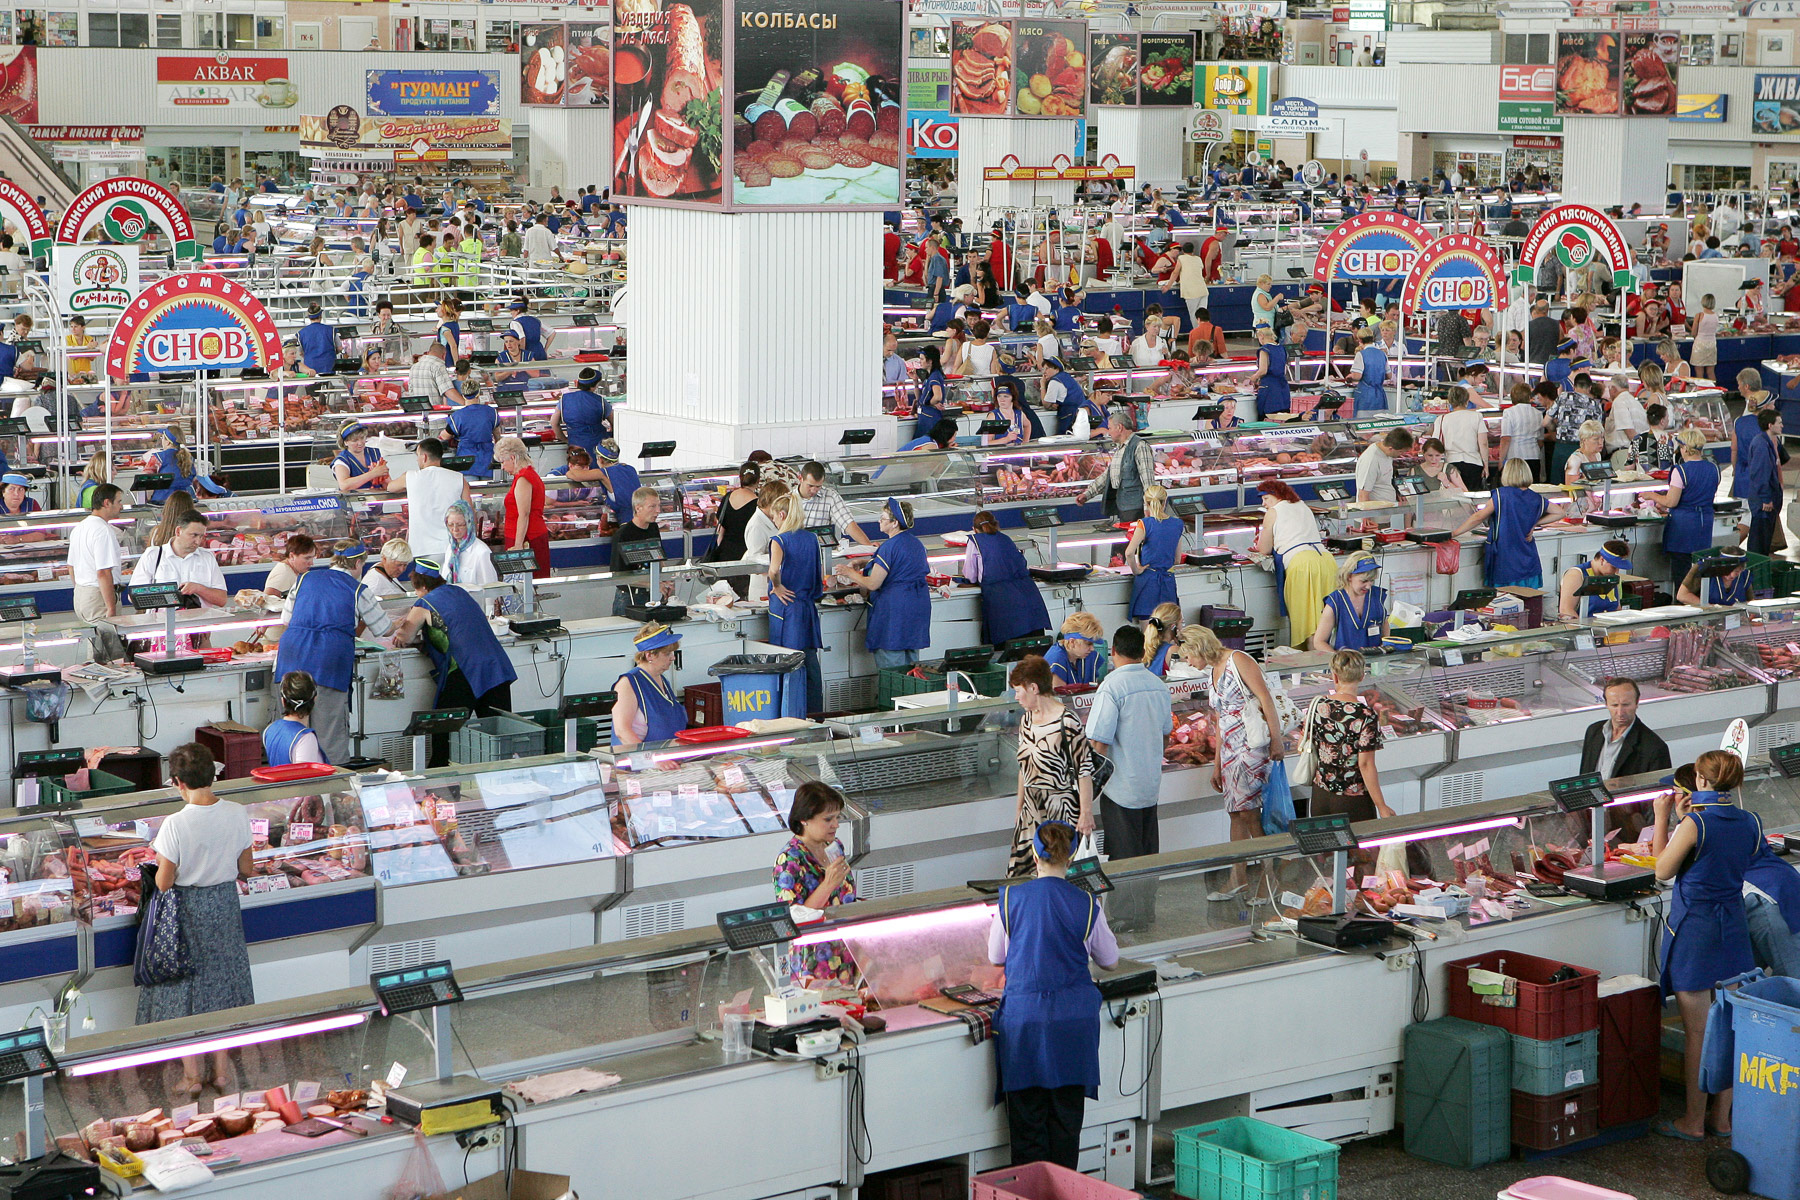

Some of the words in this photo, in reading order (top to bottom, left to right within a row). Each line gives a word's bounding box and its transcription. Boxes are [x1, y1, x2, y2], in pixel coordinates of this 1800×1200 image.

[1228, 3, 1269, 14] ИГРУШКИ
[620, 10, 672, 26] ИЗДЕЛИЯ
[741, 11, 838, 30] КОЛБАСЫ
[571, 30, 600, 38] ПТИЦА
[955, 26, 977, 35] МЯСО
[1019, 27, 1043, 36] МЯСО
[620, 31, 636, 46] ИЗ
[640, 31, 672, 45] МЯСА
[1562, 38, 1585, 46] МЯСО
[1626, 37, 1646, 45] МЯСО
[193, 66, 256, 81] AKBAR
[931, 71, 949, 82] РЫБ
[401, 98, 437, 106] ПРОДУКТЫ
[1213, 98, 1252, 106] БАКАЛЕЯ
[1271, 118, 1319, 126] САЛОМ
[1501, 116, 1518, 124] САЛОН
[1519, 116, 1542, 124] СОТОВОЙ
[1543, 117, 1561, 125] СВЯЗИ
[29, 127, 66, 138] САМЫЕ
[68, 127, 109, 138] НИЗКИЕ
[0, 180, 45, 236] ОМБИНАТ
[62, 185, 105, 240] МИНСКИЙ
[107, 181, 189, 238] МЯСОКОМБИНАТ
[1524, 213, 1558, 263] МИНСКИЙ
[1559, 209, 1626, 268] МЯСОКОМБИНАТ
[1404, 237, 1508, 307] АГРОКОМБИНАТ
[1427, 279, 1487, 302] СНОВ
[111, 276, 280, 369] АГРОКОМБИНАТ
[148, 331, 244, 362] СНОВ
[1264, 427, 1315, 437] "ТАРАСОВО"
[275, 504, 320, 513] АГРОКОМБИНАТА
[318, 498, 338, 509] СНОВ
[1170, 682, 1208, 696] омбина
[592, 842, 603, 853] 41
[380, 869, 391, 880] 41
